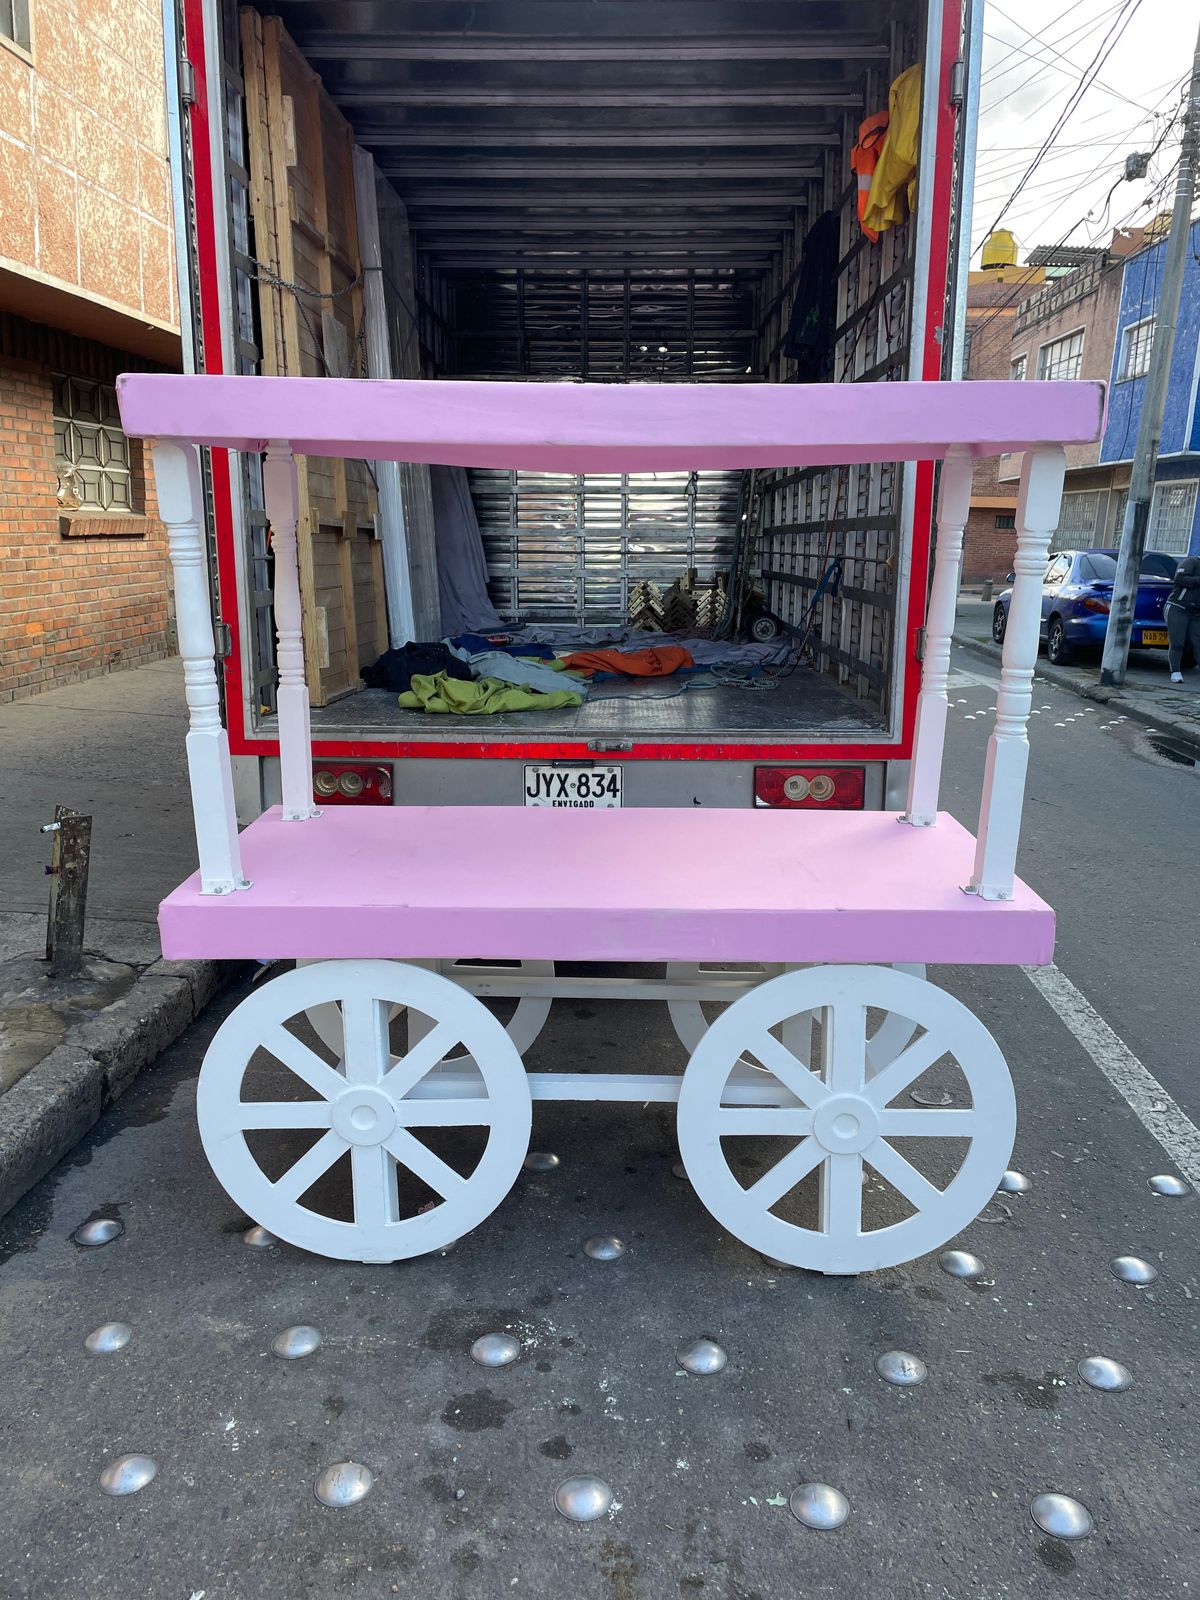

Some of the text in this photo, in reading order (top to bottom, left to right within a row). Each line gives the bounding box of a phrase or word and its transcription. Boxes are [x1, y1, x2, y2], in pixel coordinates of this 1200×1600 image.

[526, 773, 620, 798] JYX 834
[552, 800, 594, 808] ENVIGADO
